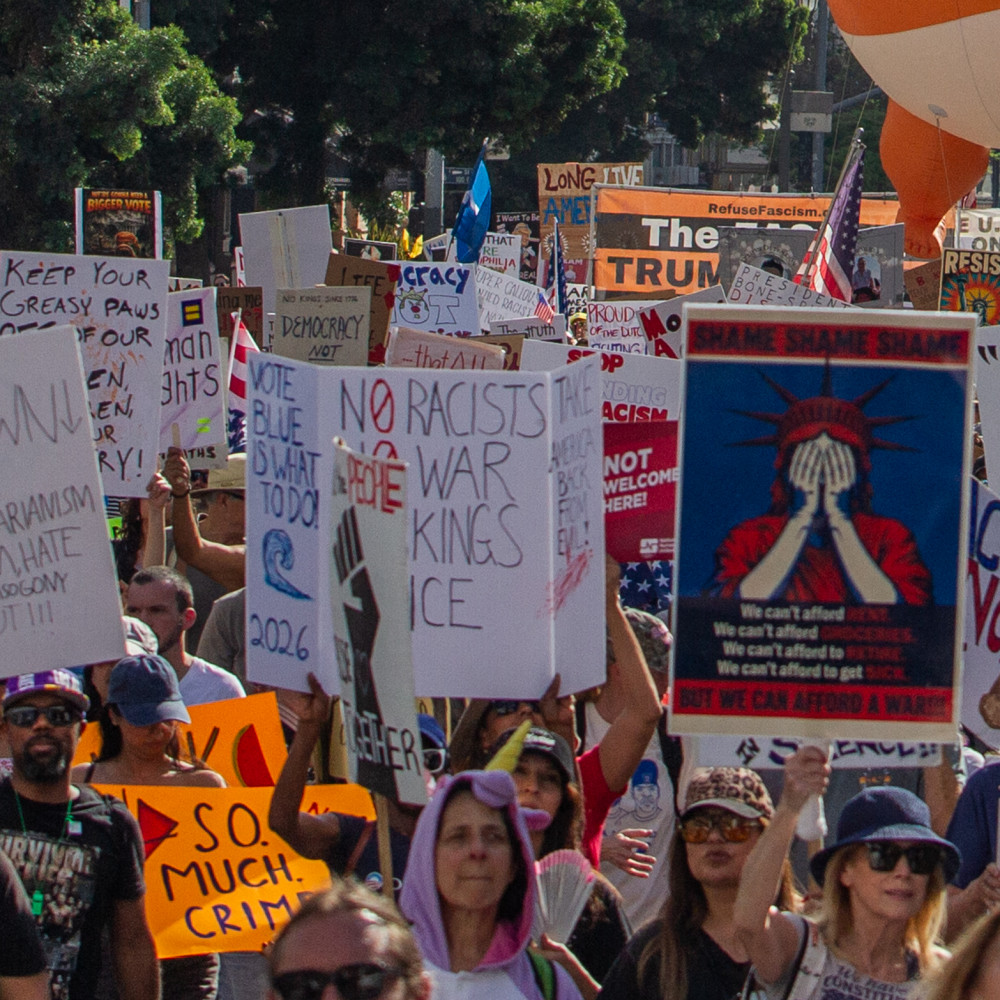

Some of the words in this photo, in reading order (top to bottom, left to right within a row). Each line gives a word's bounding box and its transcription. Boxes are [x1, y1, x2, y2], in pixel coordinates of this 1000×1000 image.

[86, 198, 124, 213] BIGGER
[125, 199, 152, 214] VOTE
[486, 235, 515, 246] THAT
[641, 217, 720, 250] The
[5, 258, 76, 286] KEEP
[93, 261, 151, 290] YOUR
[398, 265, 470, 294] cracy
[0, 290, 92, 316] GREASY
[105, 297, 160, 320] PAWS
[588, 303, 635, 324] PROUD
[101, 326, 151, 347] OUR
[281, 314, 365, 341] DEMOCRACY
[693, 325, 776, 351] SHAME
[784, 327, 870, 354] SHAME
[876, 331, 963, 359] SHAME
[308, 344, 343, 357] NOT
[250, 361, 296, 402] VOTE
[253, 398, 305, 447] BLUE
[407, 377, 547, 439] RACISTS
[252, 439, 268, 476] IS
[271, 447, 323, 488] WHAT
[416, 441, 516, 501] WAR
[603, 447, 653, 476] NOT
[603, 466, 680, 495] WELCOME
[260, 480, 284, 518] TO
[288, 486, 320, 530] DO!
[603, 491, 648, 514] HERE!
[20, 526, 83, 575] HATE
[413, 503, 523, 568] KINGS
[410, 575, 483, 632] ICE
[740, 603, 763, 620] We
[764, 604, 801, 621] can't
[802, 605, 845, 622] afford
[250, 614, 310, 662] 2026
[713, 621, 736, 638] We
[737, 622, 774, 638] can't
[775, 624, 819, 640] afford
[722, 640, 746, 657] We
[746, 641, 783, 658] can't
[784, 643, 827, 659] afford
[829, 645, 845, 659] to
[716, 659, 740, 676] We
[741, 660, 777, 677] can't
[778, 662, 822, 678] afford
[823, 664, 838, 678] to
[839, 665, 863, 682] get
[719, 689, 746, 710] WE
[751, 690, 789, 712] CAN
[792, 691, 863, 714] AFFORD
[867, 694, 880, 713] A
[194, 802, 269, 853] SO.
[161, 853, 303, 902] MUCH.
